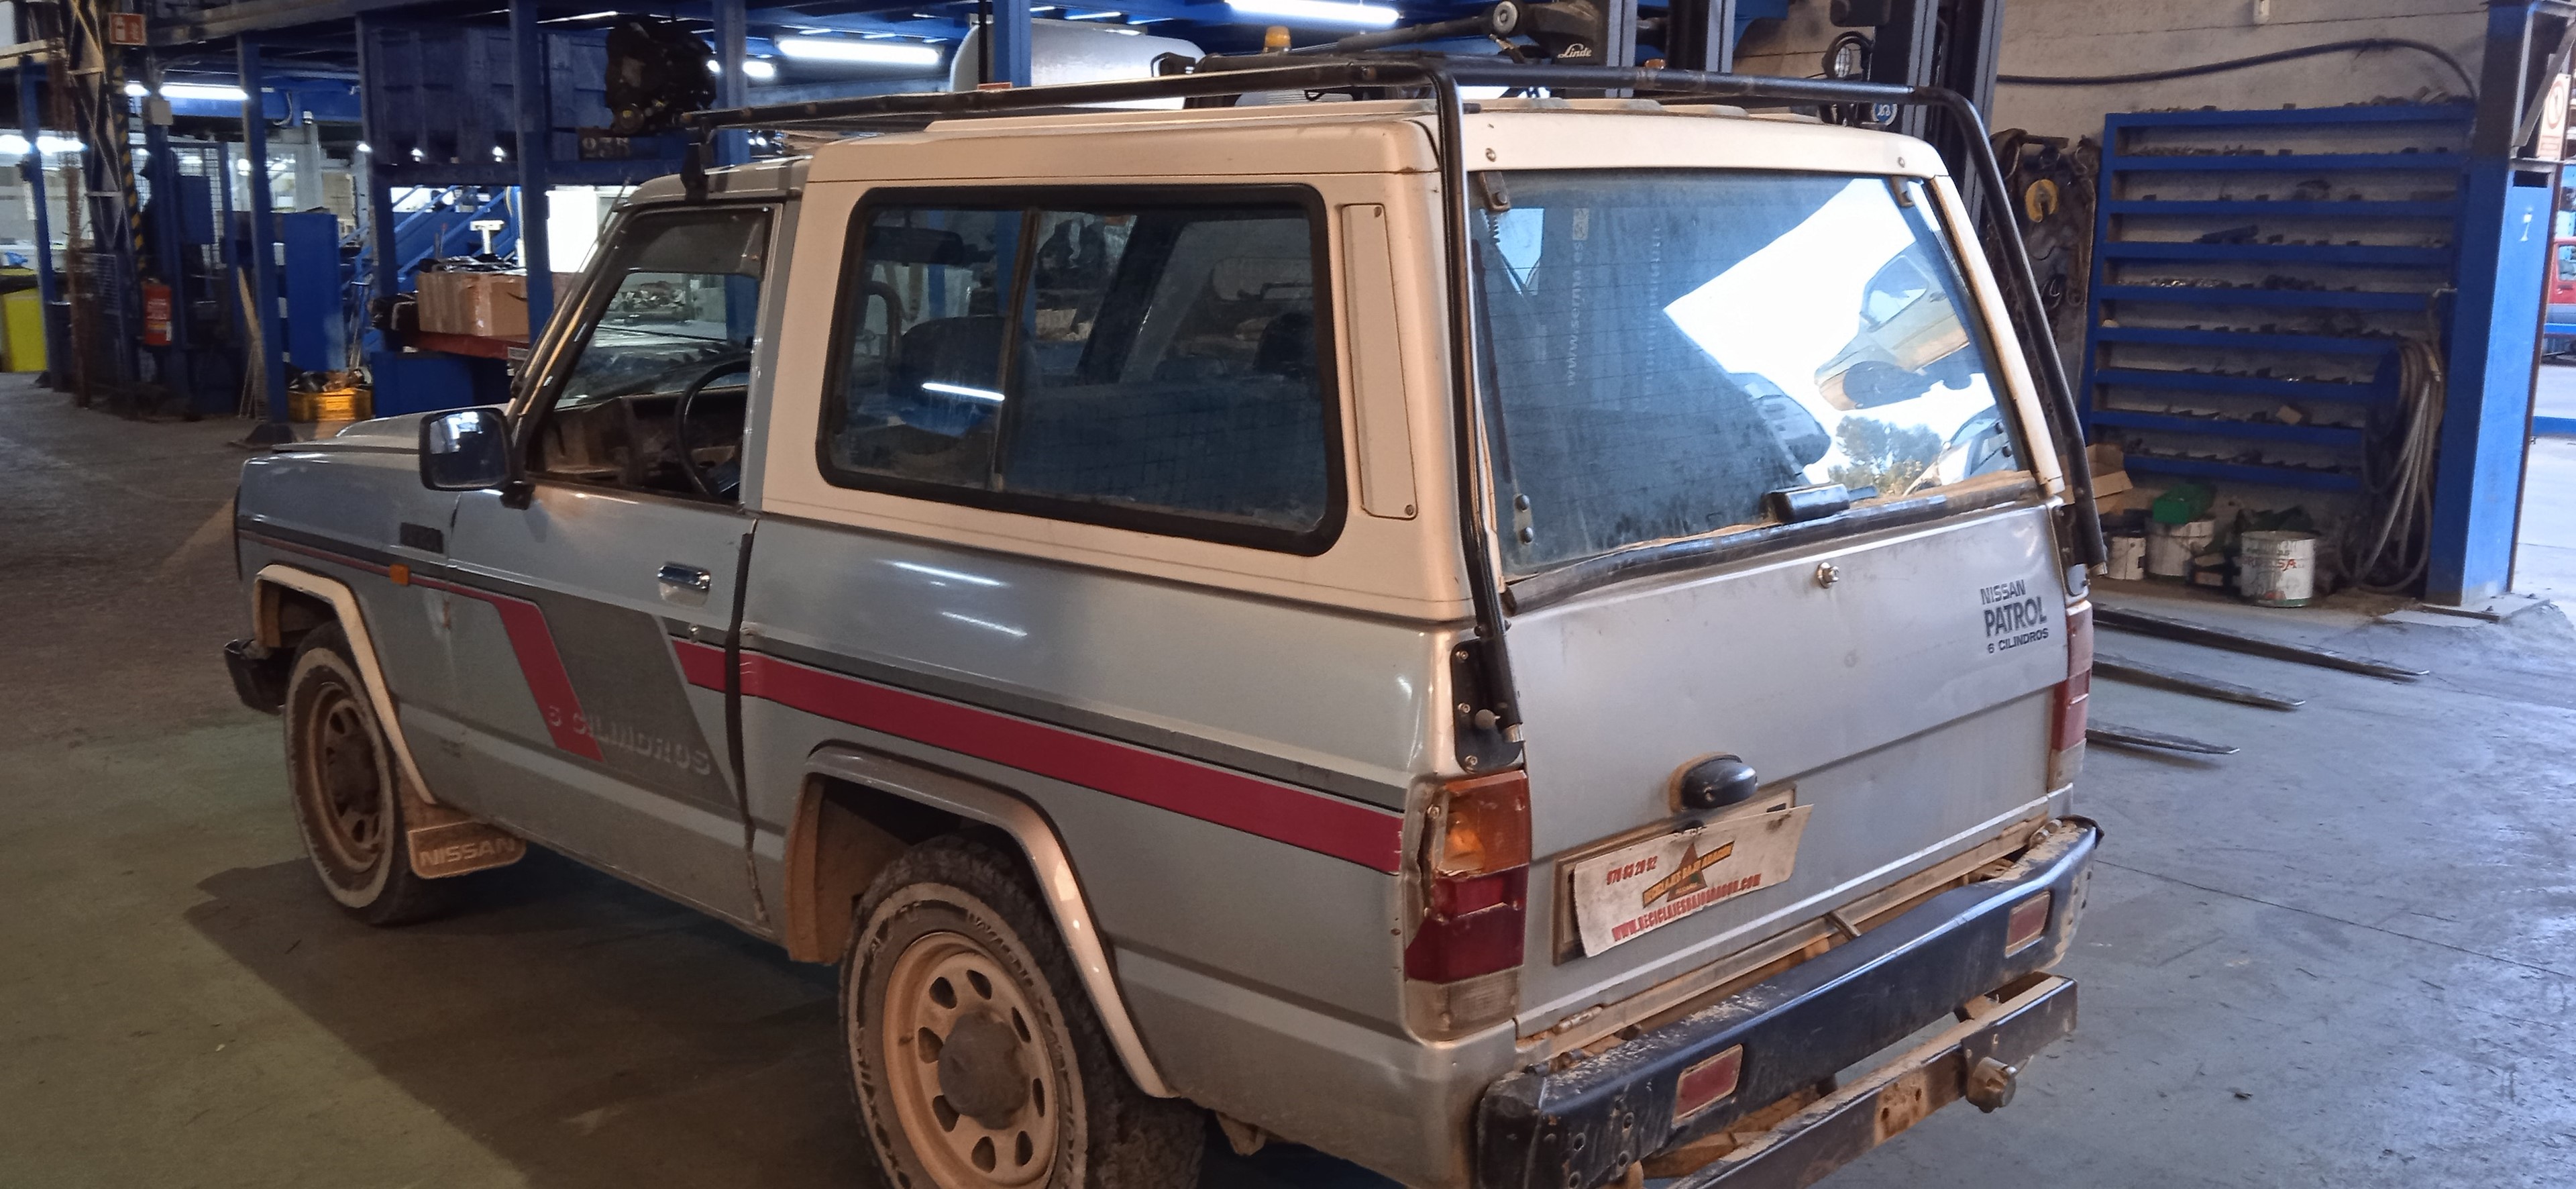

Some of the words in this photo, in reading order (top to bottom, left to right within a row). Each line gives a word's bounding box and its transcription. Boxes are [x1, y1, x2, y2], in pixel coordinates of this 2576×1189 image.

[1557, 43, 1592, 58] Linde
[1980, 579, 2026, 605] NISSAN
[1984, 597, 2047, 637] PATROL
[1988, 643, 1995, 654] 6
[1998, 628, 2049, 651] CILINDROS
[419, 838, 516, 866] NISSAN
